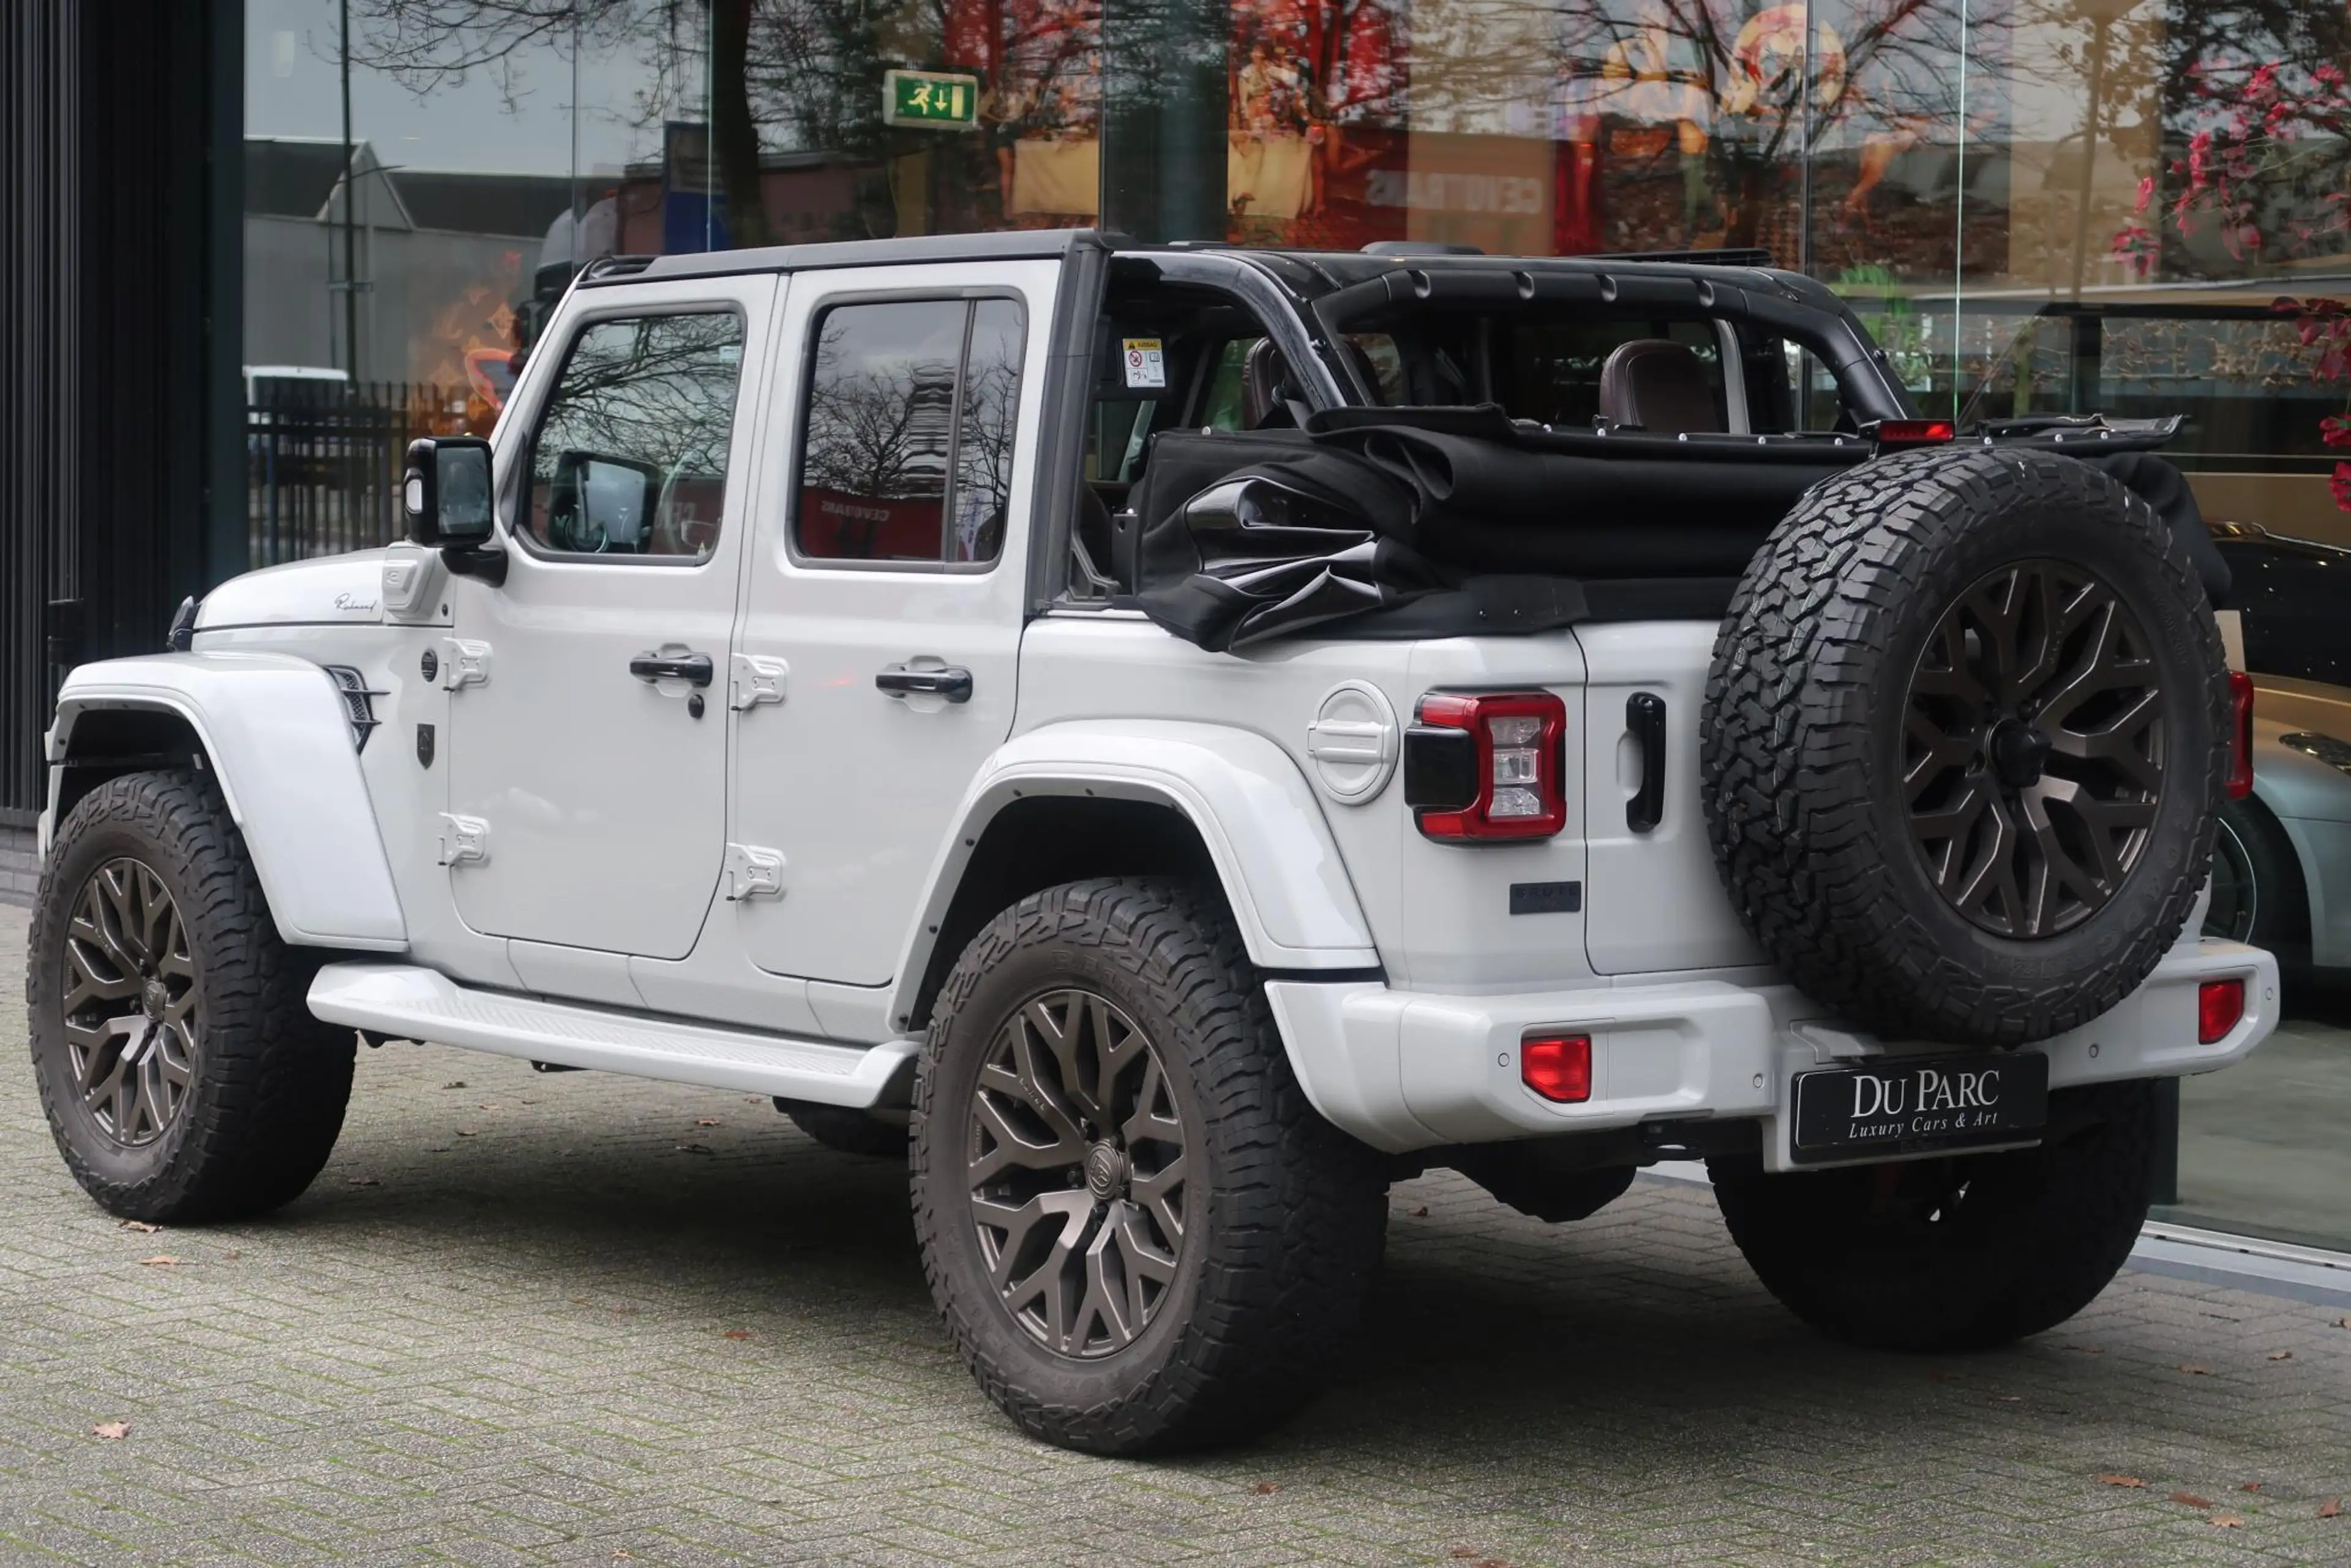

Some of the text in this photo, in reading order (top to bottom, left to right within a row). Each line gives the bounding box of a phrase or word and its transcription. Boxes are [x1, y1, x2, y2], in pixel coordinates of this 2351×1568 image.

[1851, 1070, 2000, 1117] DU PARC
[1849, 1111, 1998, 1138] Luxury Cars & Art
